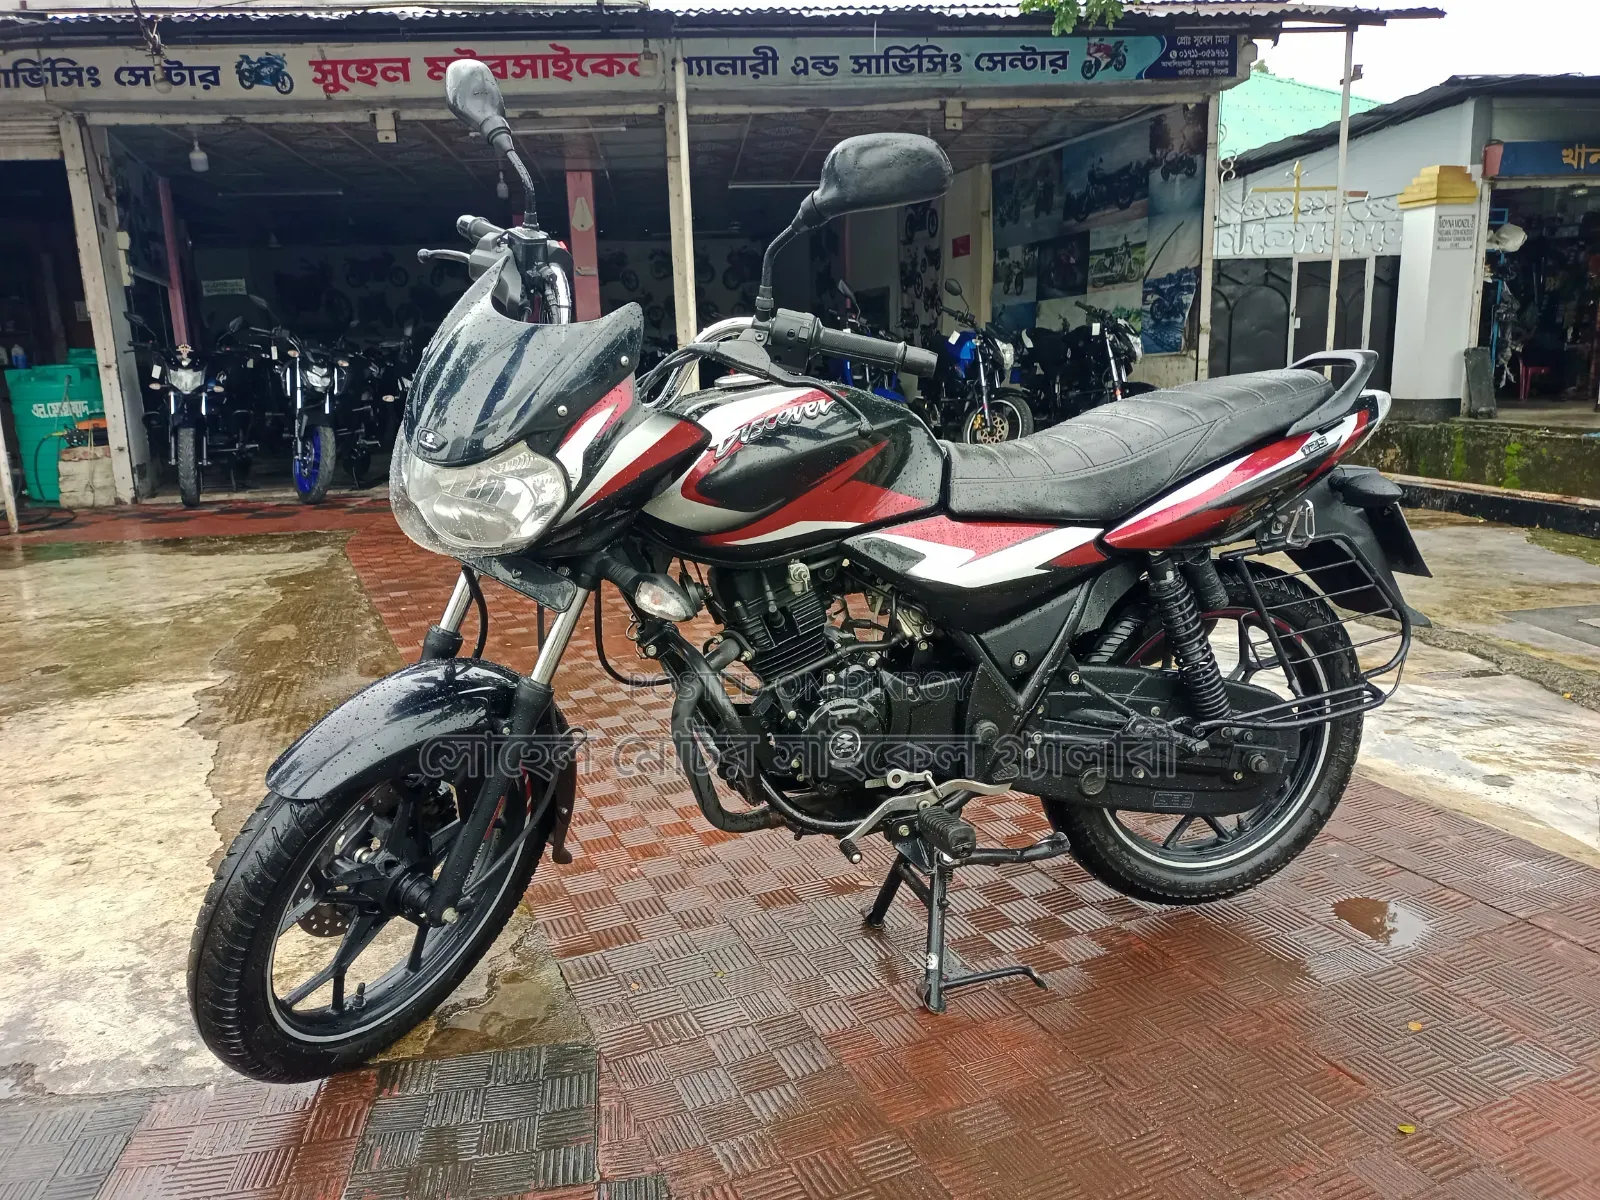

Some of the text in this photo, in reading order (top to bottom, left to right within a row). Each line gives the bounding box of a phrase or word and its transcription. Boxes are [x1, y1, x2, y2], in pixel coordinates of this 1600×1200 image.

[308, 57, 411, 93] সুহেল
[791, 55, 839, 77] এন্ড
[850, 44, 962, 75] সার্ভিসিং
[974, 45, 1070, 75] সেন্টার
[1301, 435, 1329, 457] 125
